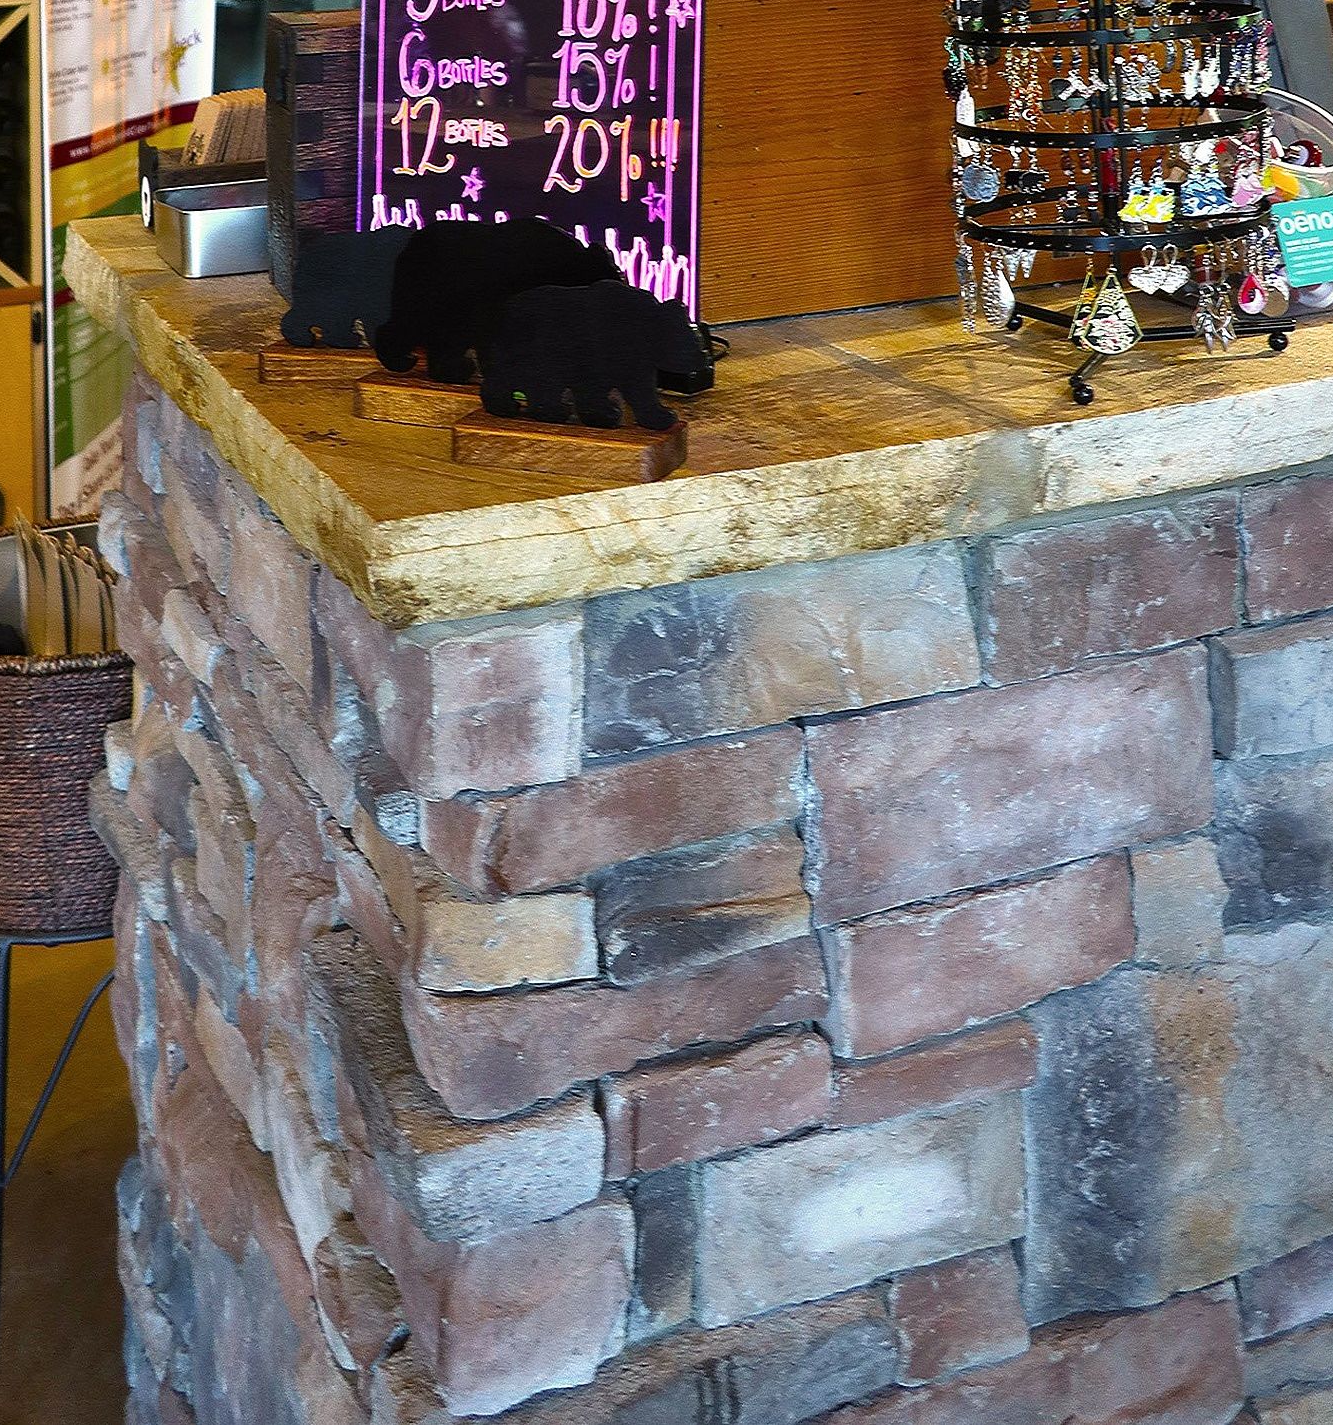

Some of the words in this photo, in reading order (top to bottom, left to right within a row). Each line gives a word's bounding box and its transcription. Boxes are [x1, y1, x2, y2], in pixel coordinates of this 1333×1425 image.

[399, 28, 436, 97] 6
[437, 55, 508, 88] BOTTLES
[391, 96, 456, 176] 12
